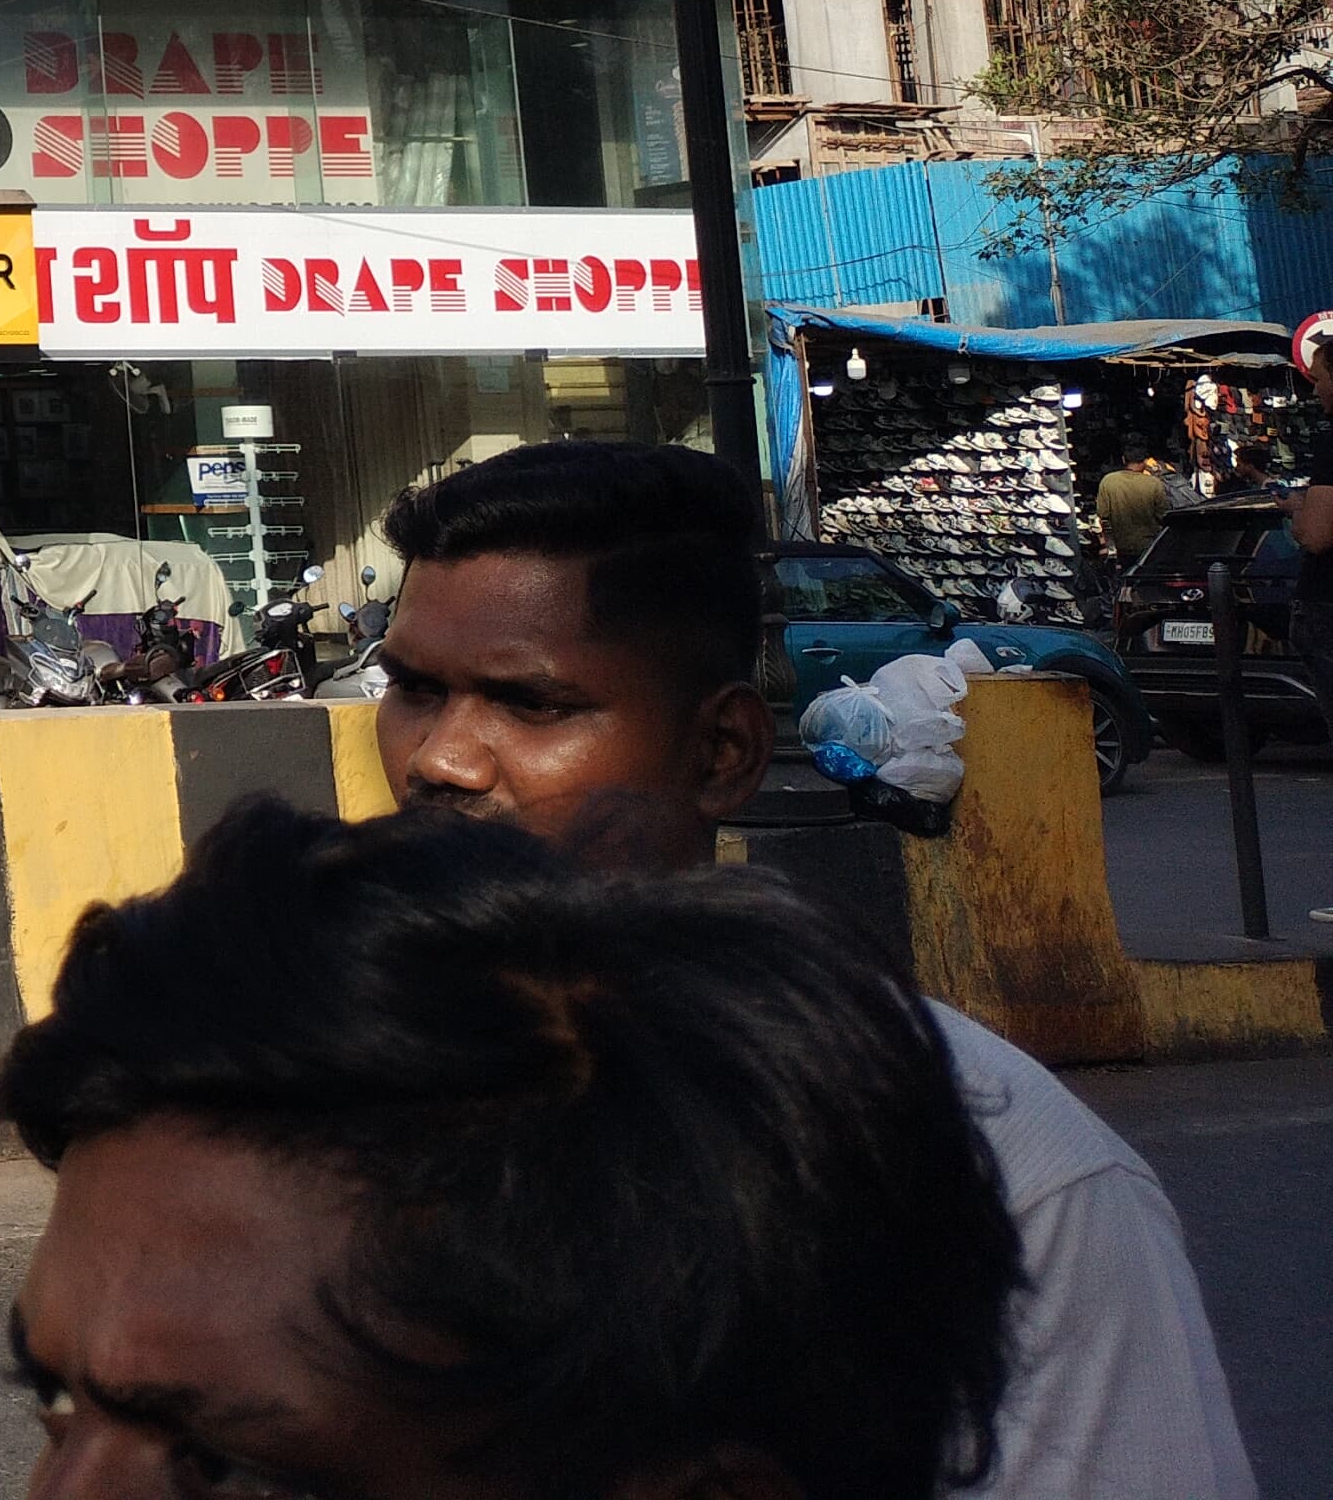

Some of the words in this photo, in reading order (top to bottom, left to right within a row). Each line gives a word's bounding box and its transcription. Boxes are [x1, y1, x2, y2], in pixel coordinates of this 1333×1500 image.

[25, 31, 323, 100] DRAPE
[32, 111, 373, 180] SHOPPE
[72, 218, 238, 324] शॉप
[261, 256, 467, 316] DRAPE
